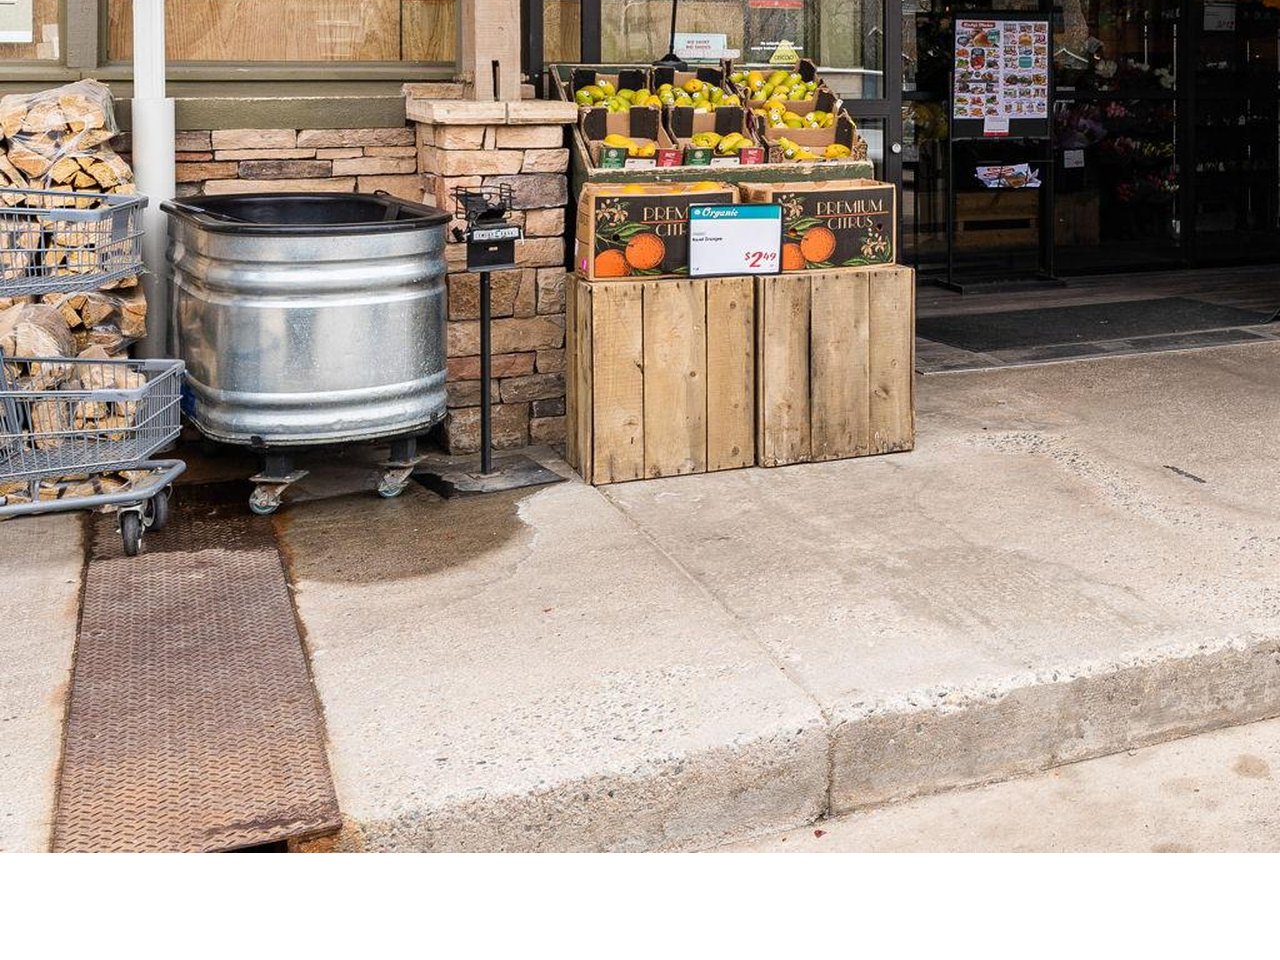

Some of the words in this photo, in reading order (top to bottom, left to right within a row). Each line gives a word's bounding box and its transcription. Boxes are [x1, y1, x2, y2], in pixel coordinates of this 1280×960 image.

[643, 206, 690, 221] PREM
[702, 207, 739, 219] Organic
[817, 199, 883, 215] PREMIUM
[655, 222, 687, 237] CITR
[827, 215, 873, 231] CITRUS
